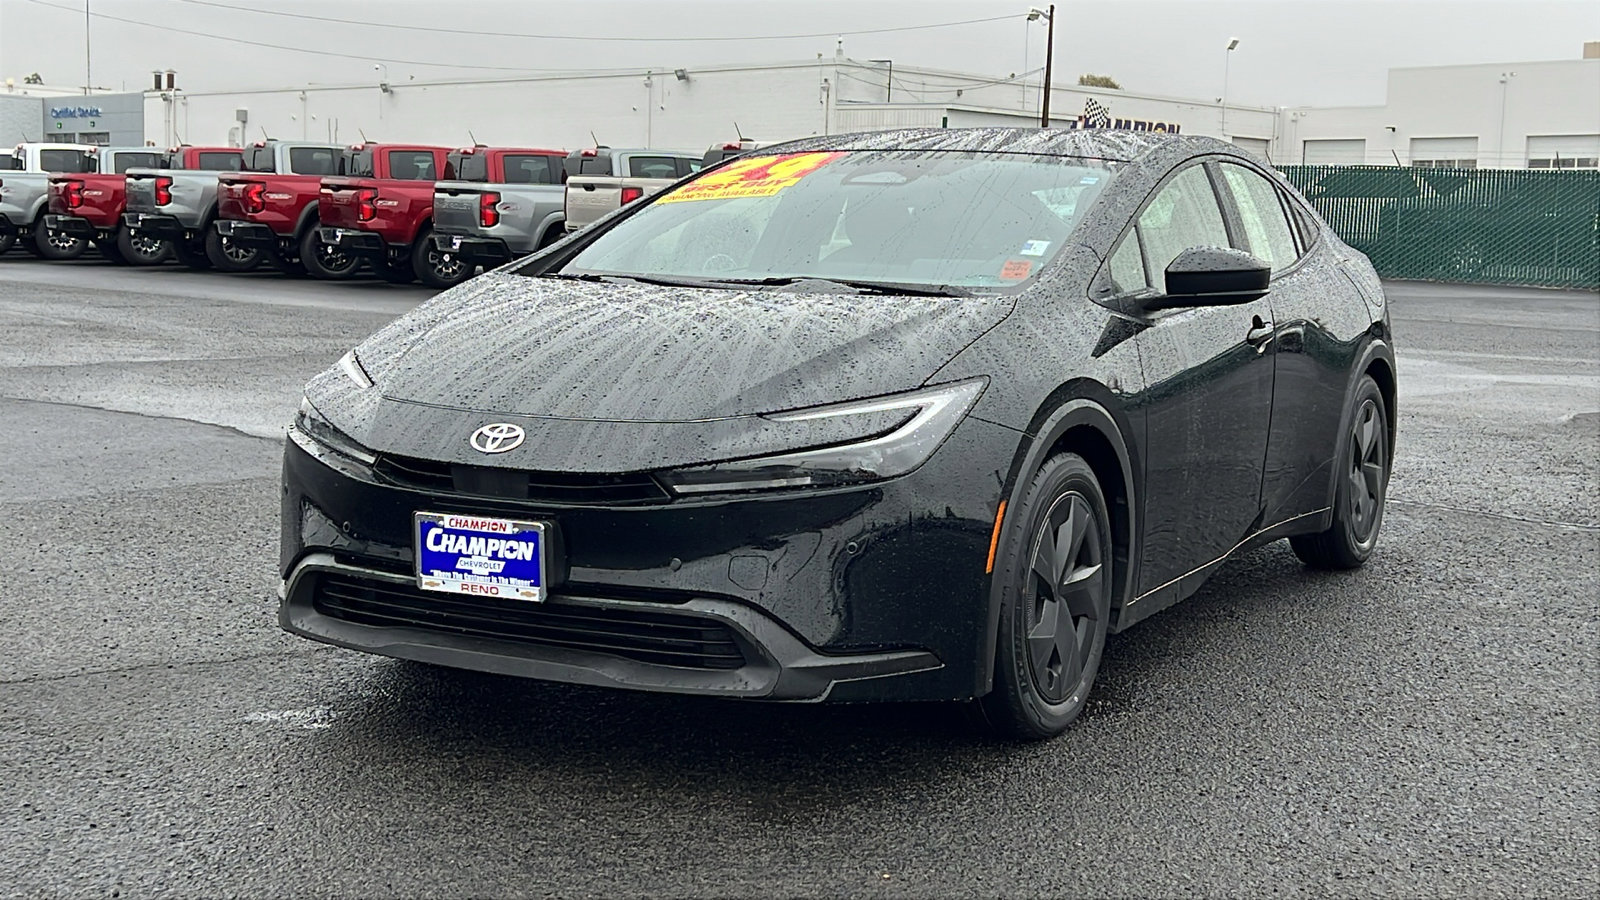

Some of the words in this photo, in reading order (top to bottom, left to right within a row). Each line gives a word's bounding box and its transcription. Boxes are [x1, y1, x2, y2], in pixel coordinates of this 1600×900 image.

[448, 517, 507, 533] CHAMPION
[426, 527, 535, 561] CHAMPION
[459, 558, 501, 570] CHEVROLET
[460, 583, 499, 595] RENO
